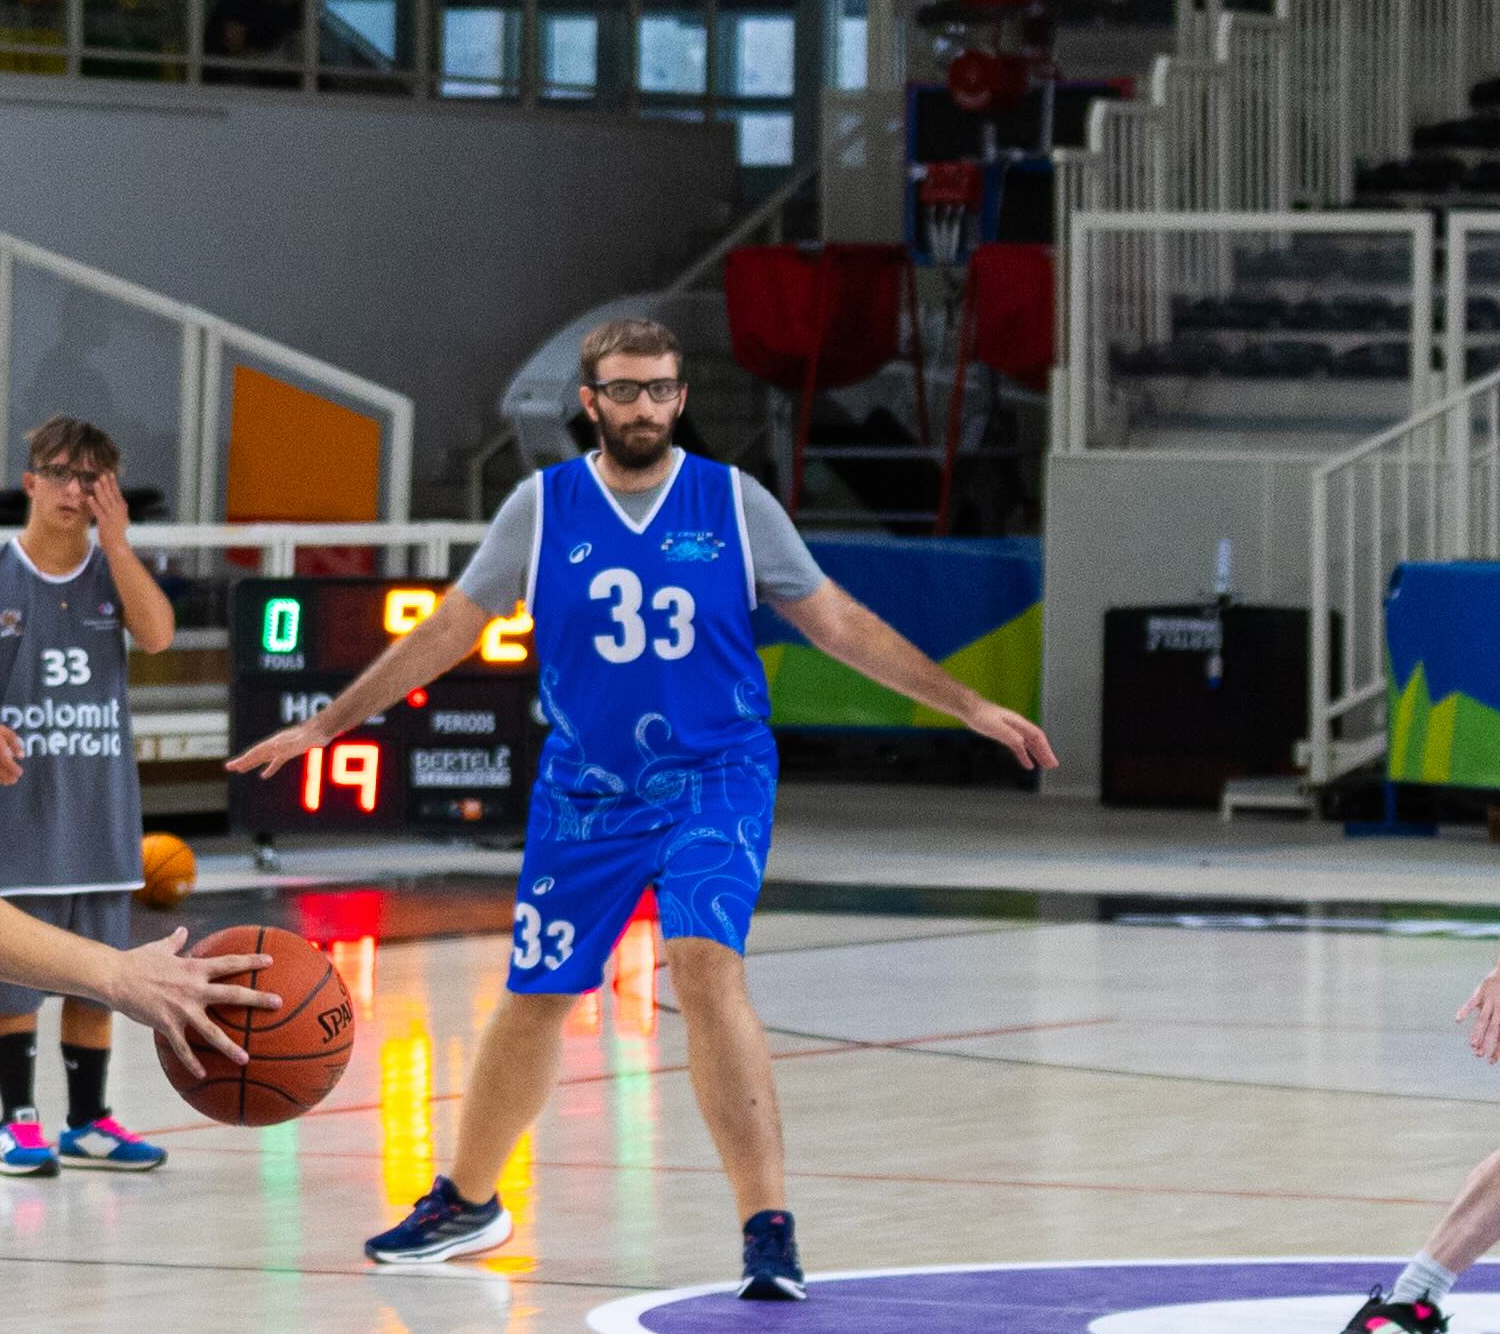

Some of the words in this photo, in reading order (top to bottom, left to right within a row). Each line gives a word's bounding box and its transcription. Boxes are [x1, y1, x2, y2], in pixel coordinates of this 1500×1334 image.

[263, 598, 300, 653] 0
[589, 567, 696, 664] 33
[41, 647, 91, 686] 33
[16, 729, 122, 757] nergia
[432, 711, 496, 734] PERIODS
[304, 741, 380, 812] 19
[513, 903, 576, 971] 33
